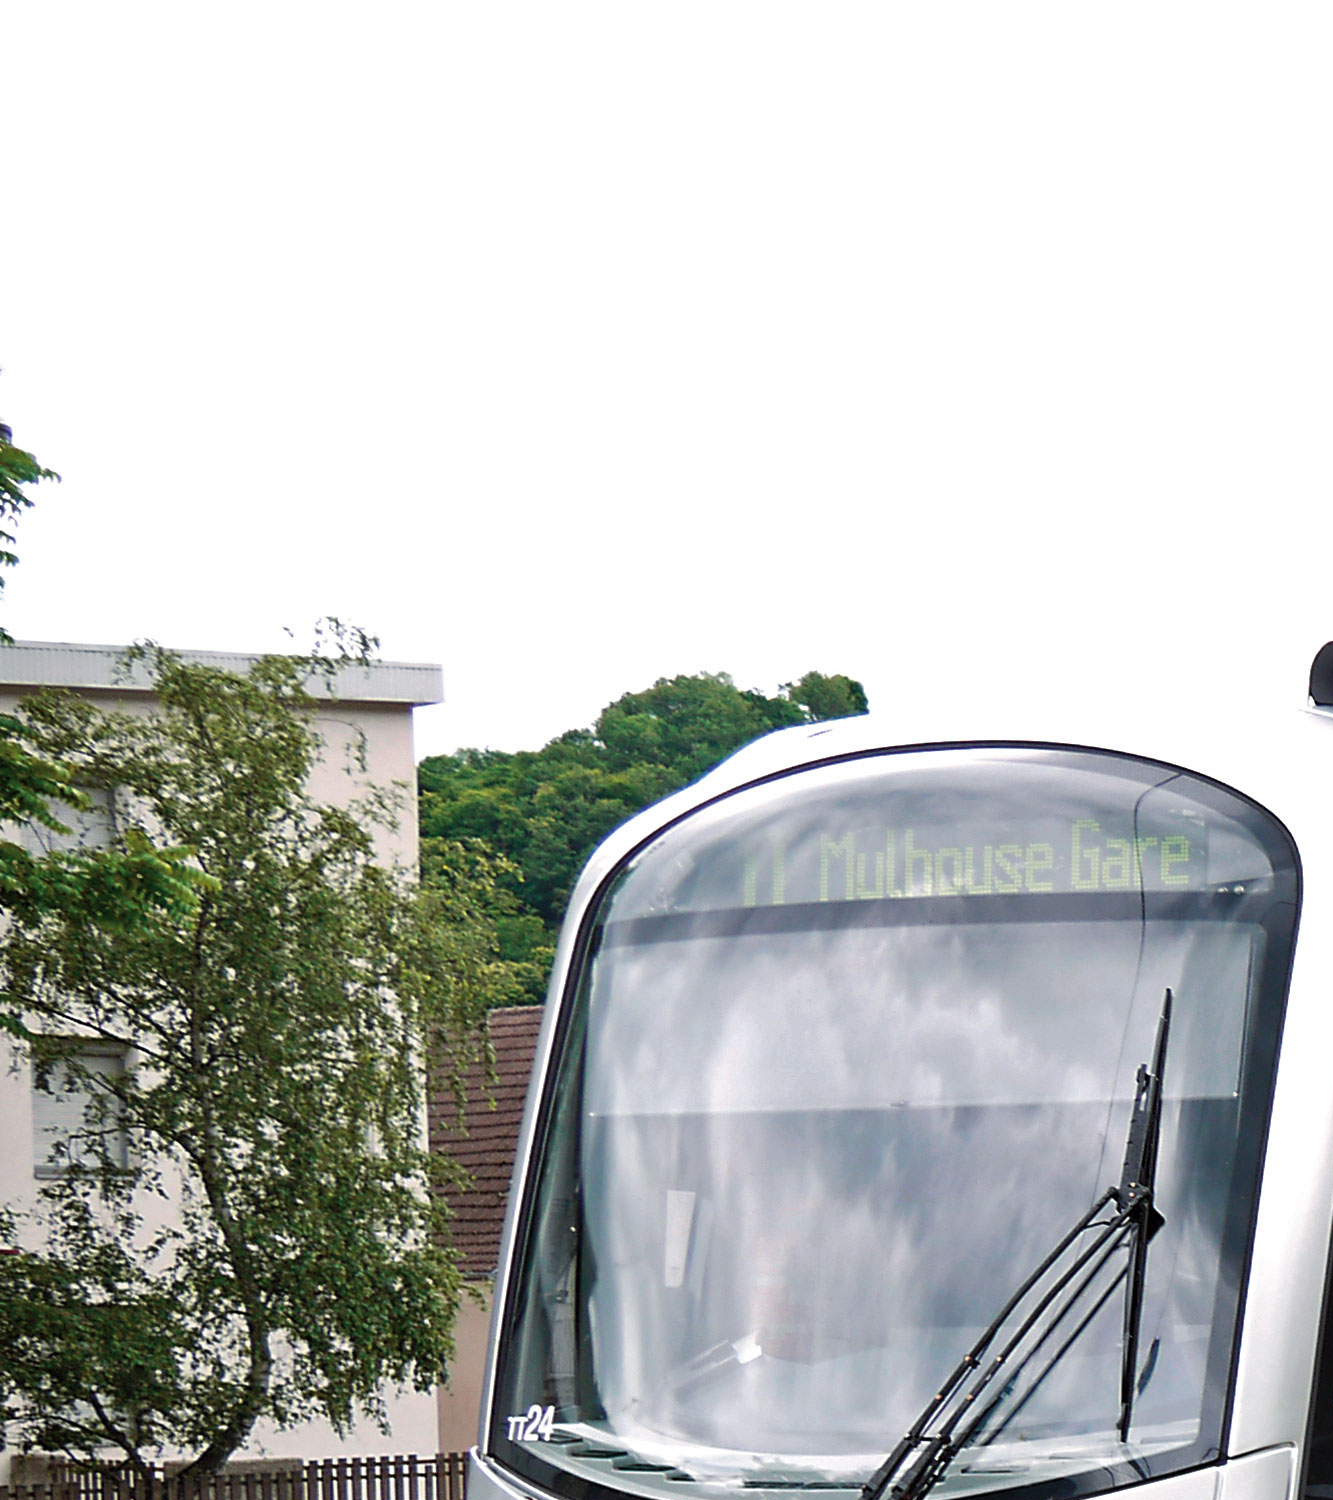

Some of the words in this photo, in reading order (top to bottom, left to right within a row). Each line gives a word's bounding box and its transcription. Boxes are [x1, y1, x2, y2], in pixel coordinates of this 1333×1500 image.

[820, 828, 1053, 901] Mulhouse
[1072, 818, 1190, 890] Gare
[507, 1404, 556, 1442] TT24
